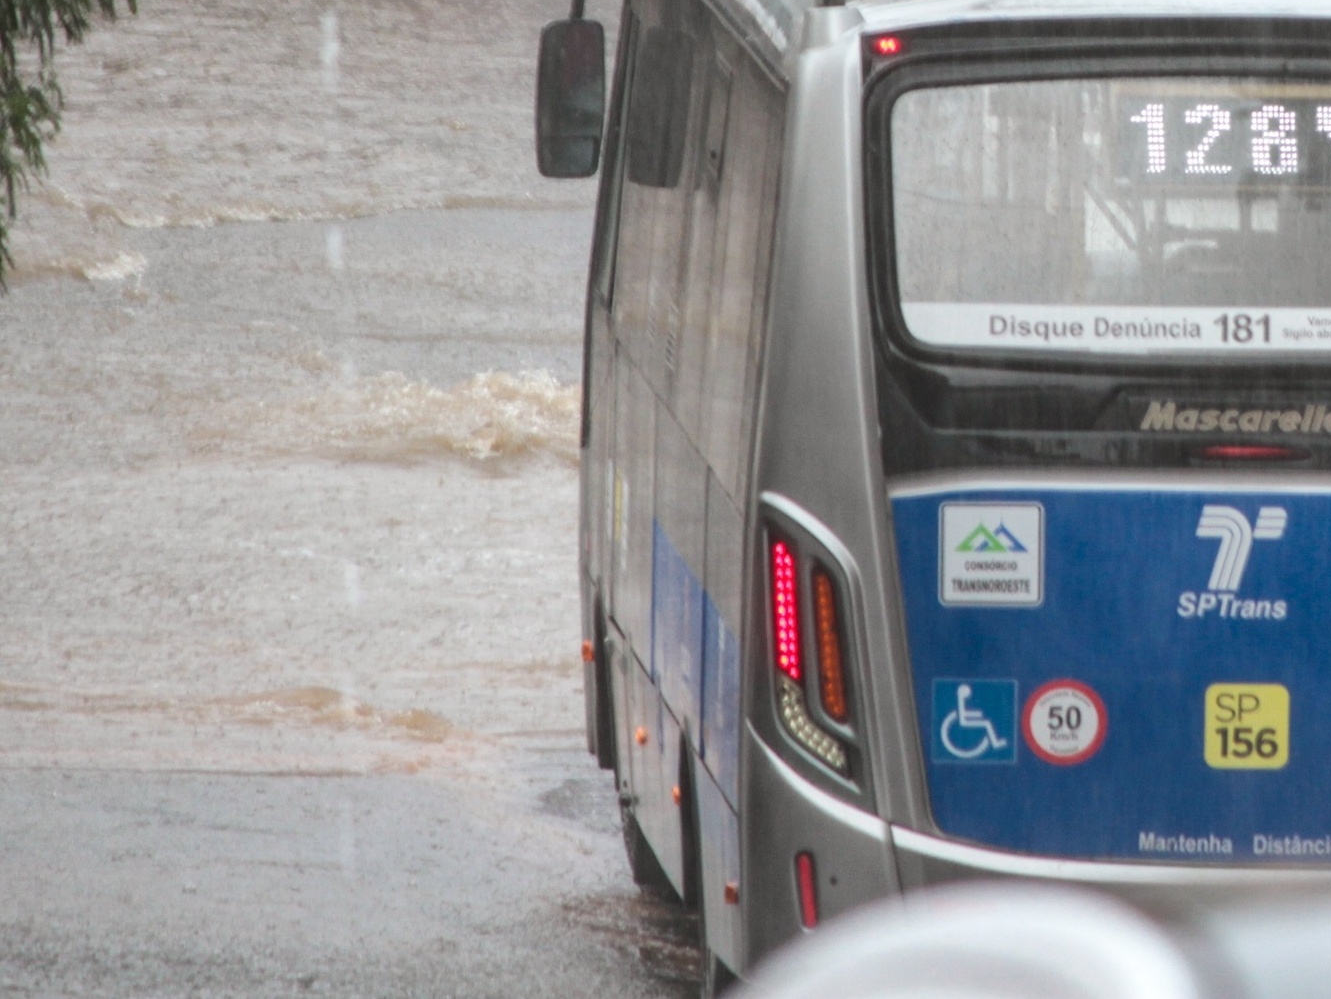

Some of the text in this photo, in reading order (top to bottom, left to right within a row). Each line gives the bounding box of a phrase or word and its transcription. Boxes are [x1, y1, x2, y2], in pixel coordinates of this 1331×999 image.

[989, 313, 1271, 343] Disque Denúncia 181
[1282, 328, 1314, 340] Sigilo
[952, 579, 1030, 594] TRANSNOROESTE
[1177, 592, 1287, 620] SPTrans
[1047, 705, 1082, 731] 50
[1215, 693, 1260, 724] SP
[1215, 727, 1279, 759] 156
[1138, 831, 1233, 853] Mantenha
